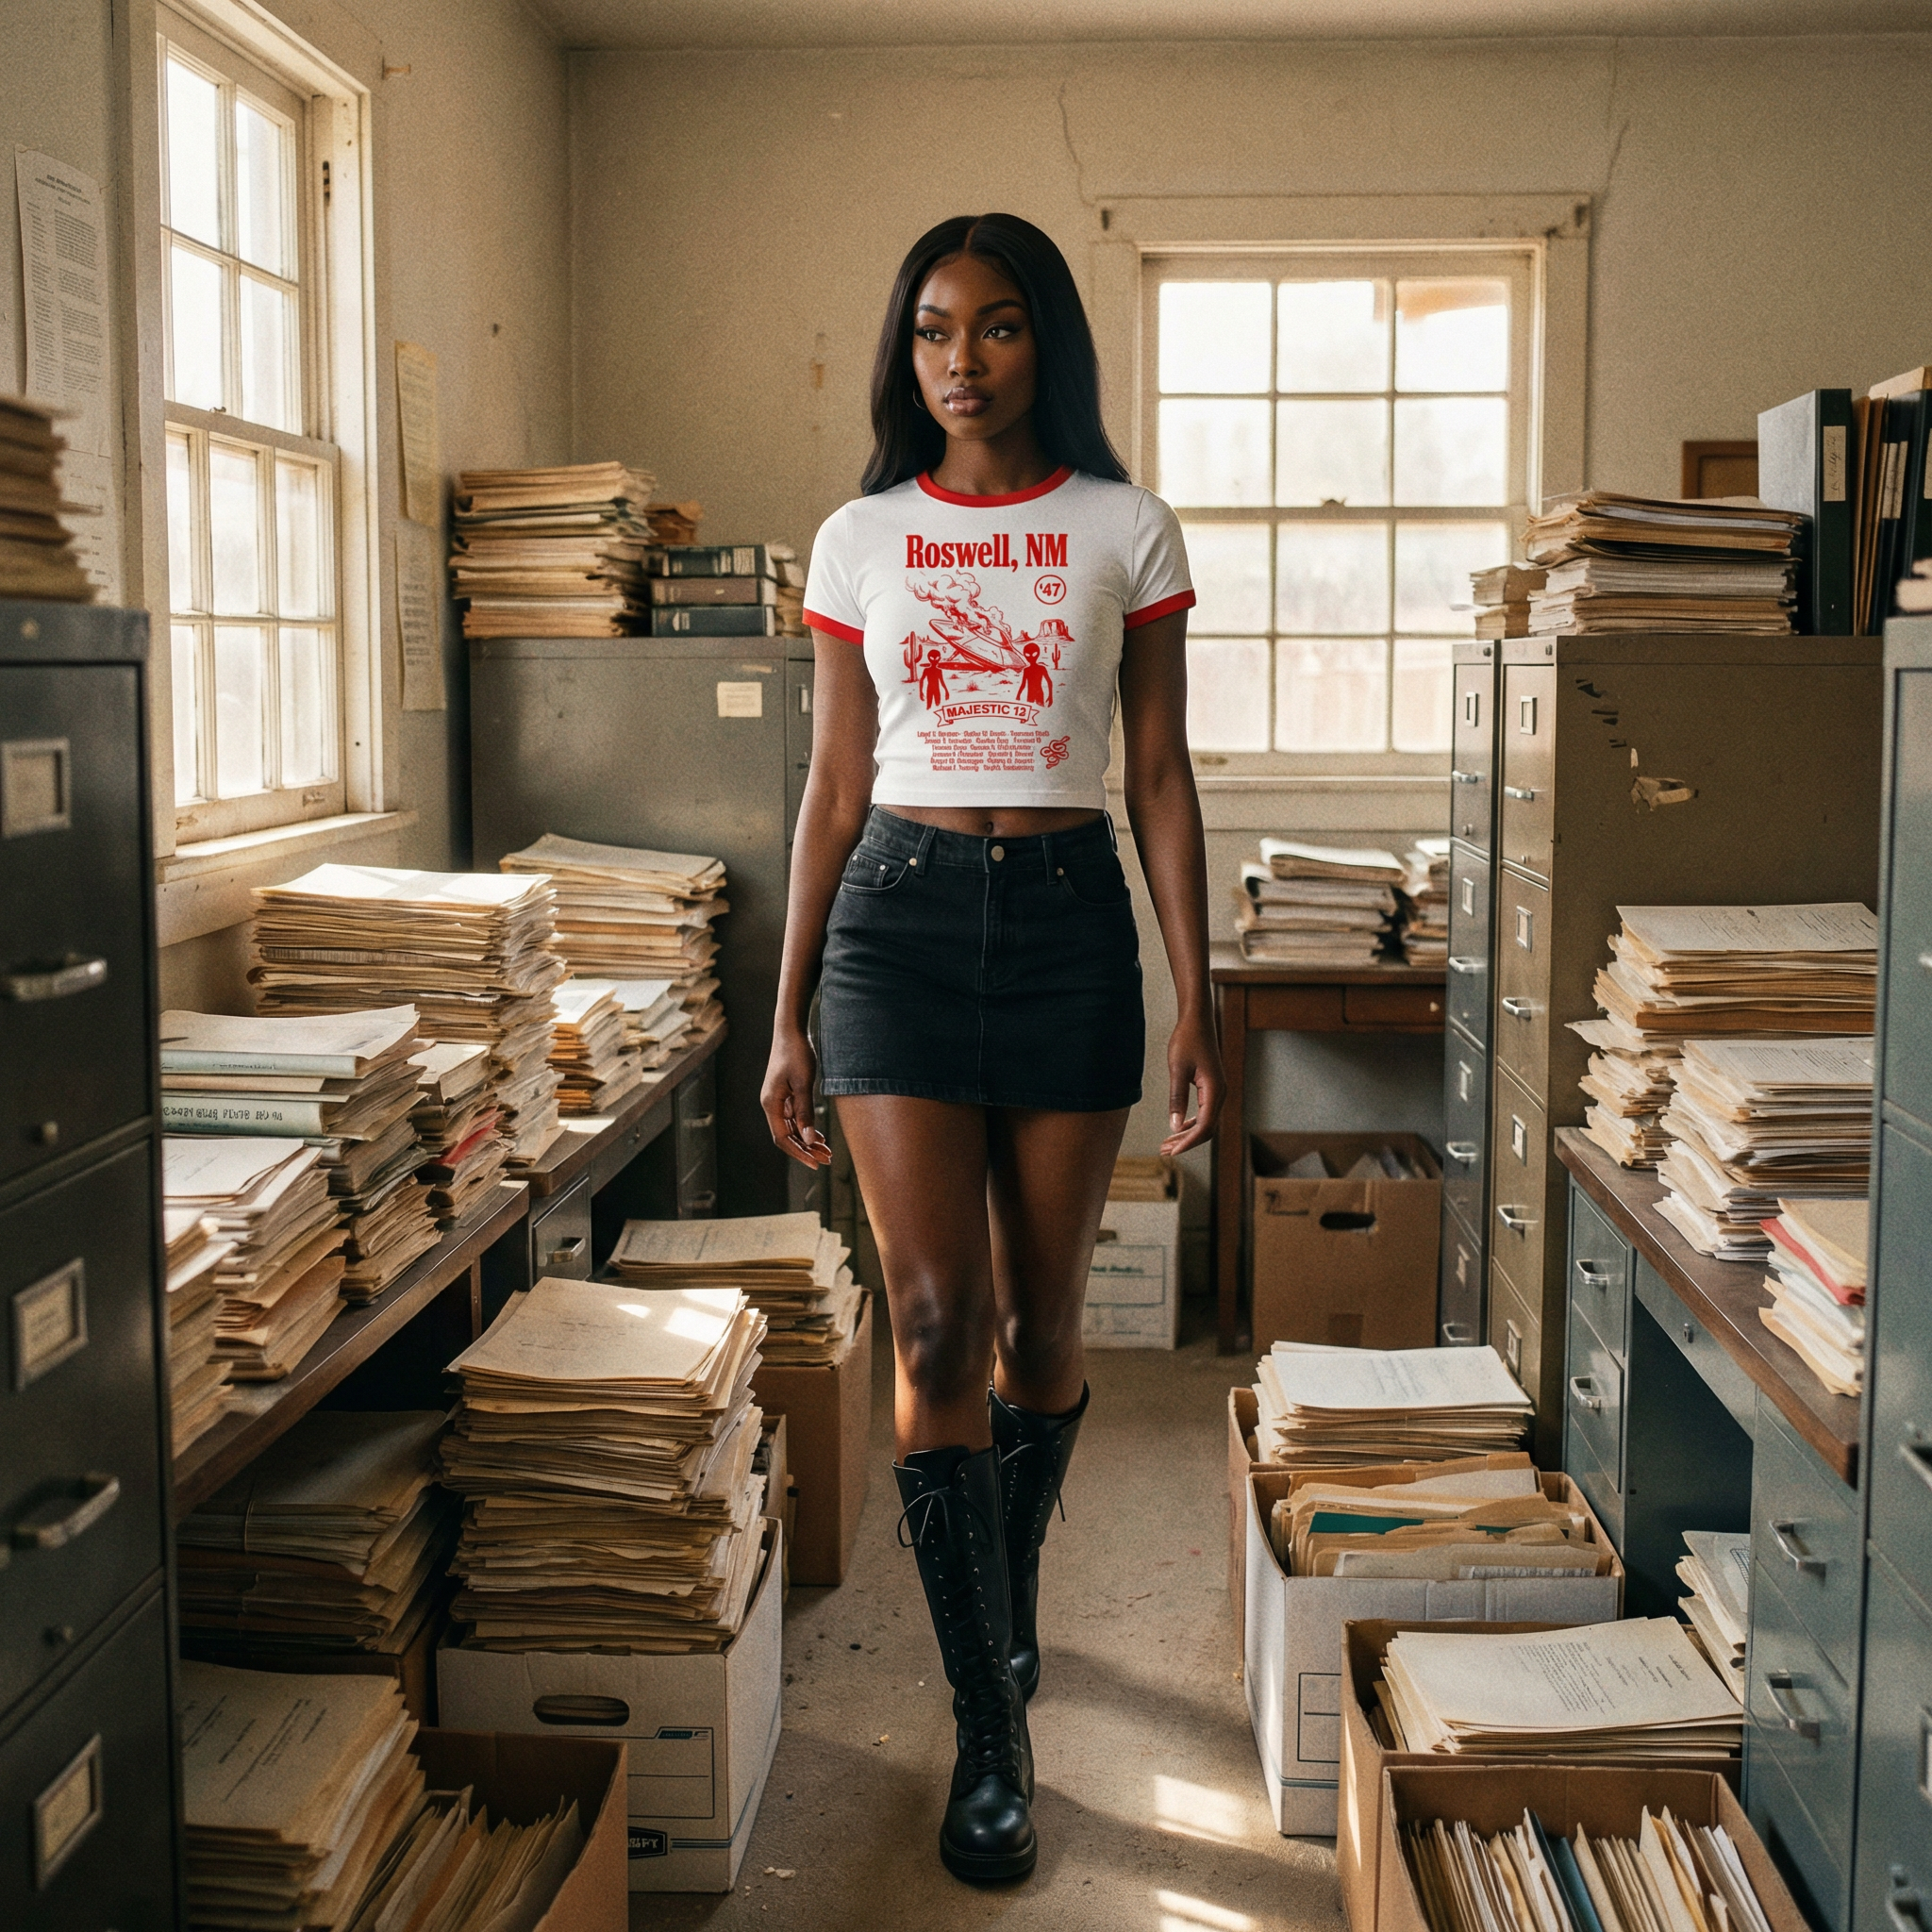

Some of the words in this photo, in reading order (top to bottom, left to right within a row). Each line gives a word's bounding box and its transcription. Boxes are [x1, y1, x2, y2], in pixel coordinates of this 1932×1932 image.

[906, 534, 1019, 572] Roswell,
[1025, 533, 1068, 567] NM
[946, 704, 1010, 717] MAJESTIC
[1013, 706, 1026, 717] 12
